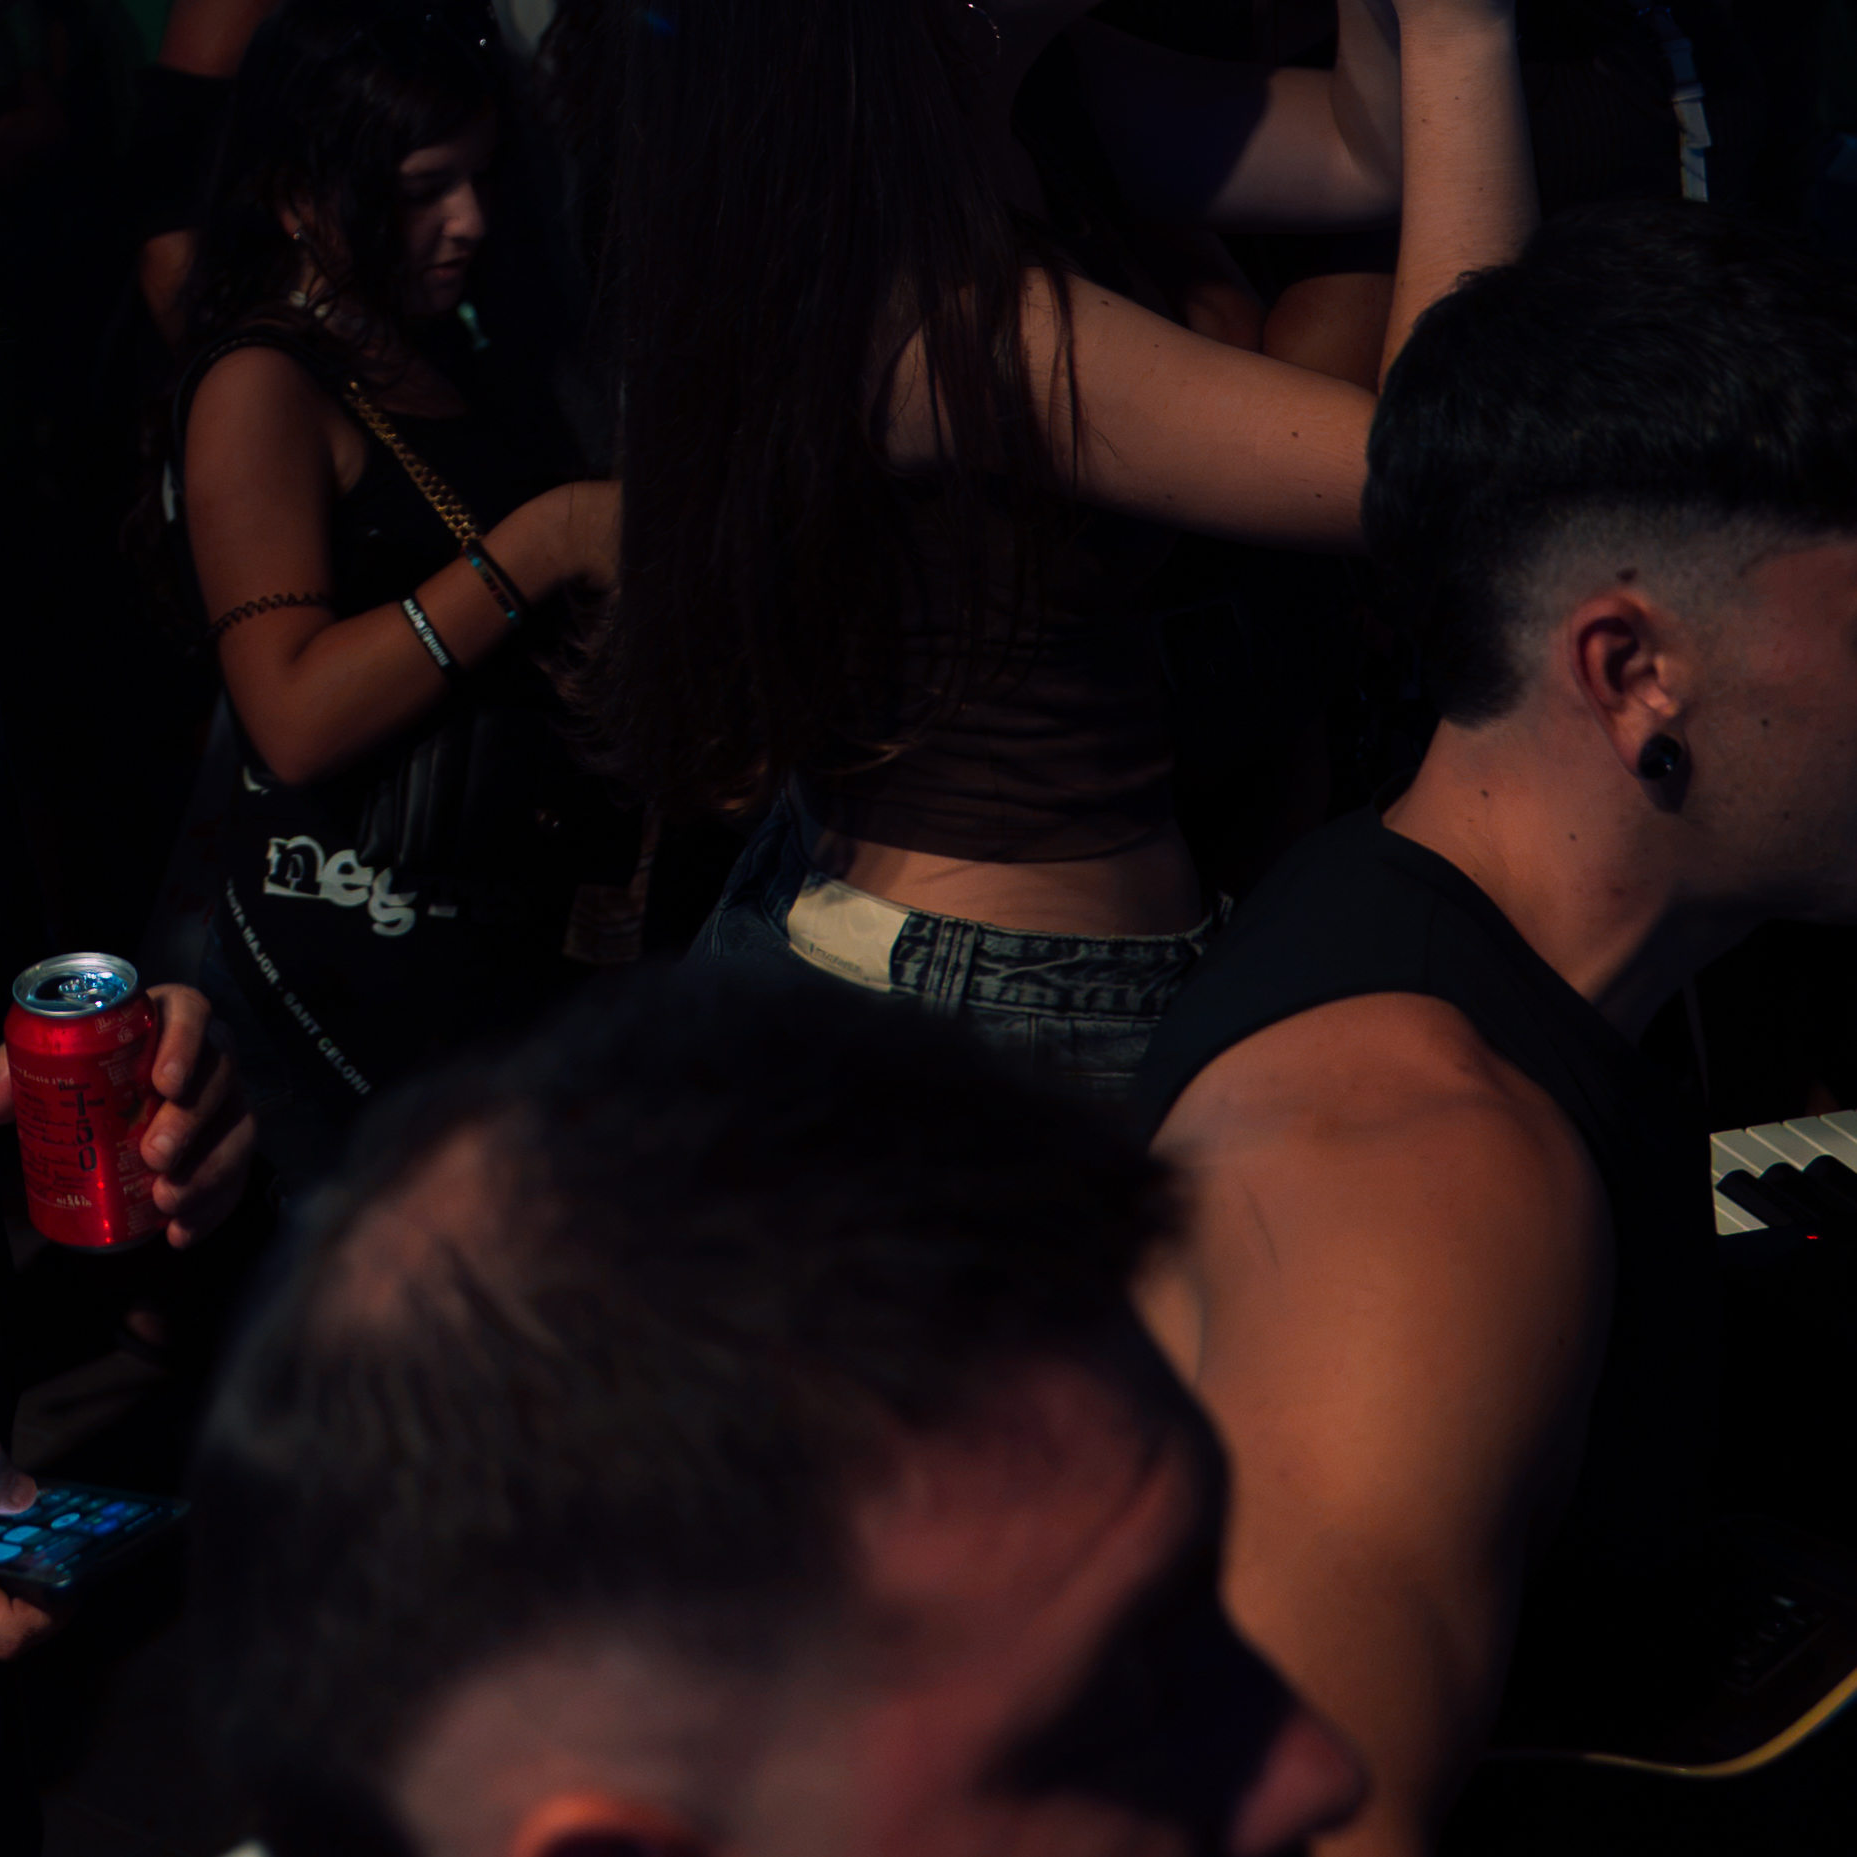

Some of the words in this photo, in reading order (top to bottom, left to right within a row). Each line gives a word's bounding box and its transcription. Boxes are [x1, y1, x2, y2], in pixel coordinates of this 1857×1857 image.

[241, 925, 281, 986] MAJOR
[281, 991, 323, 1037] SANT
[316, 1036, 373, 1097] CELONI
